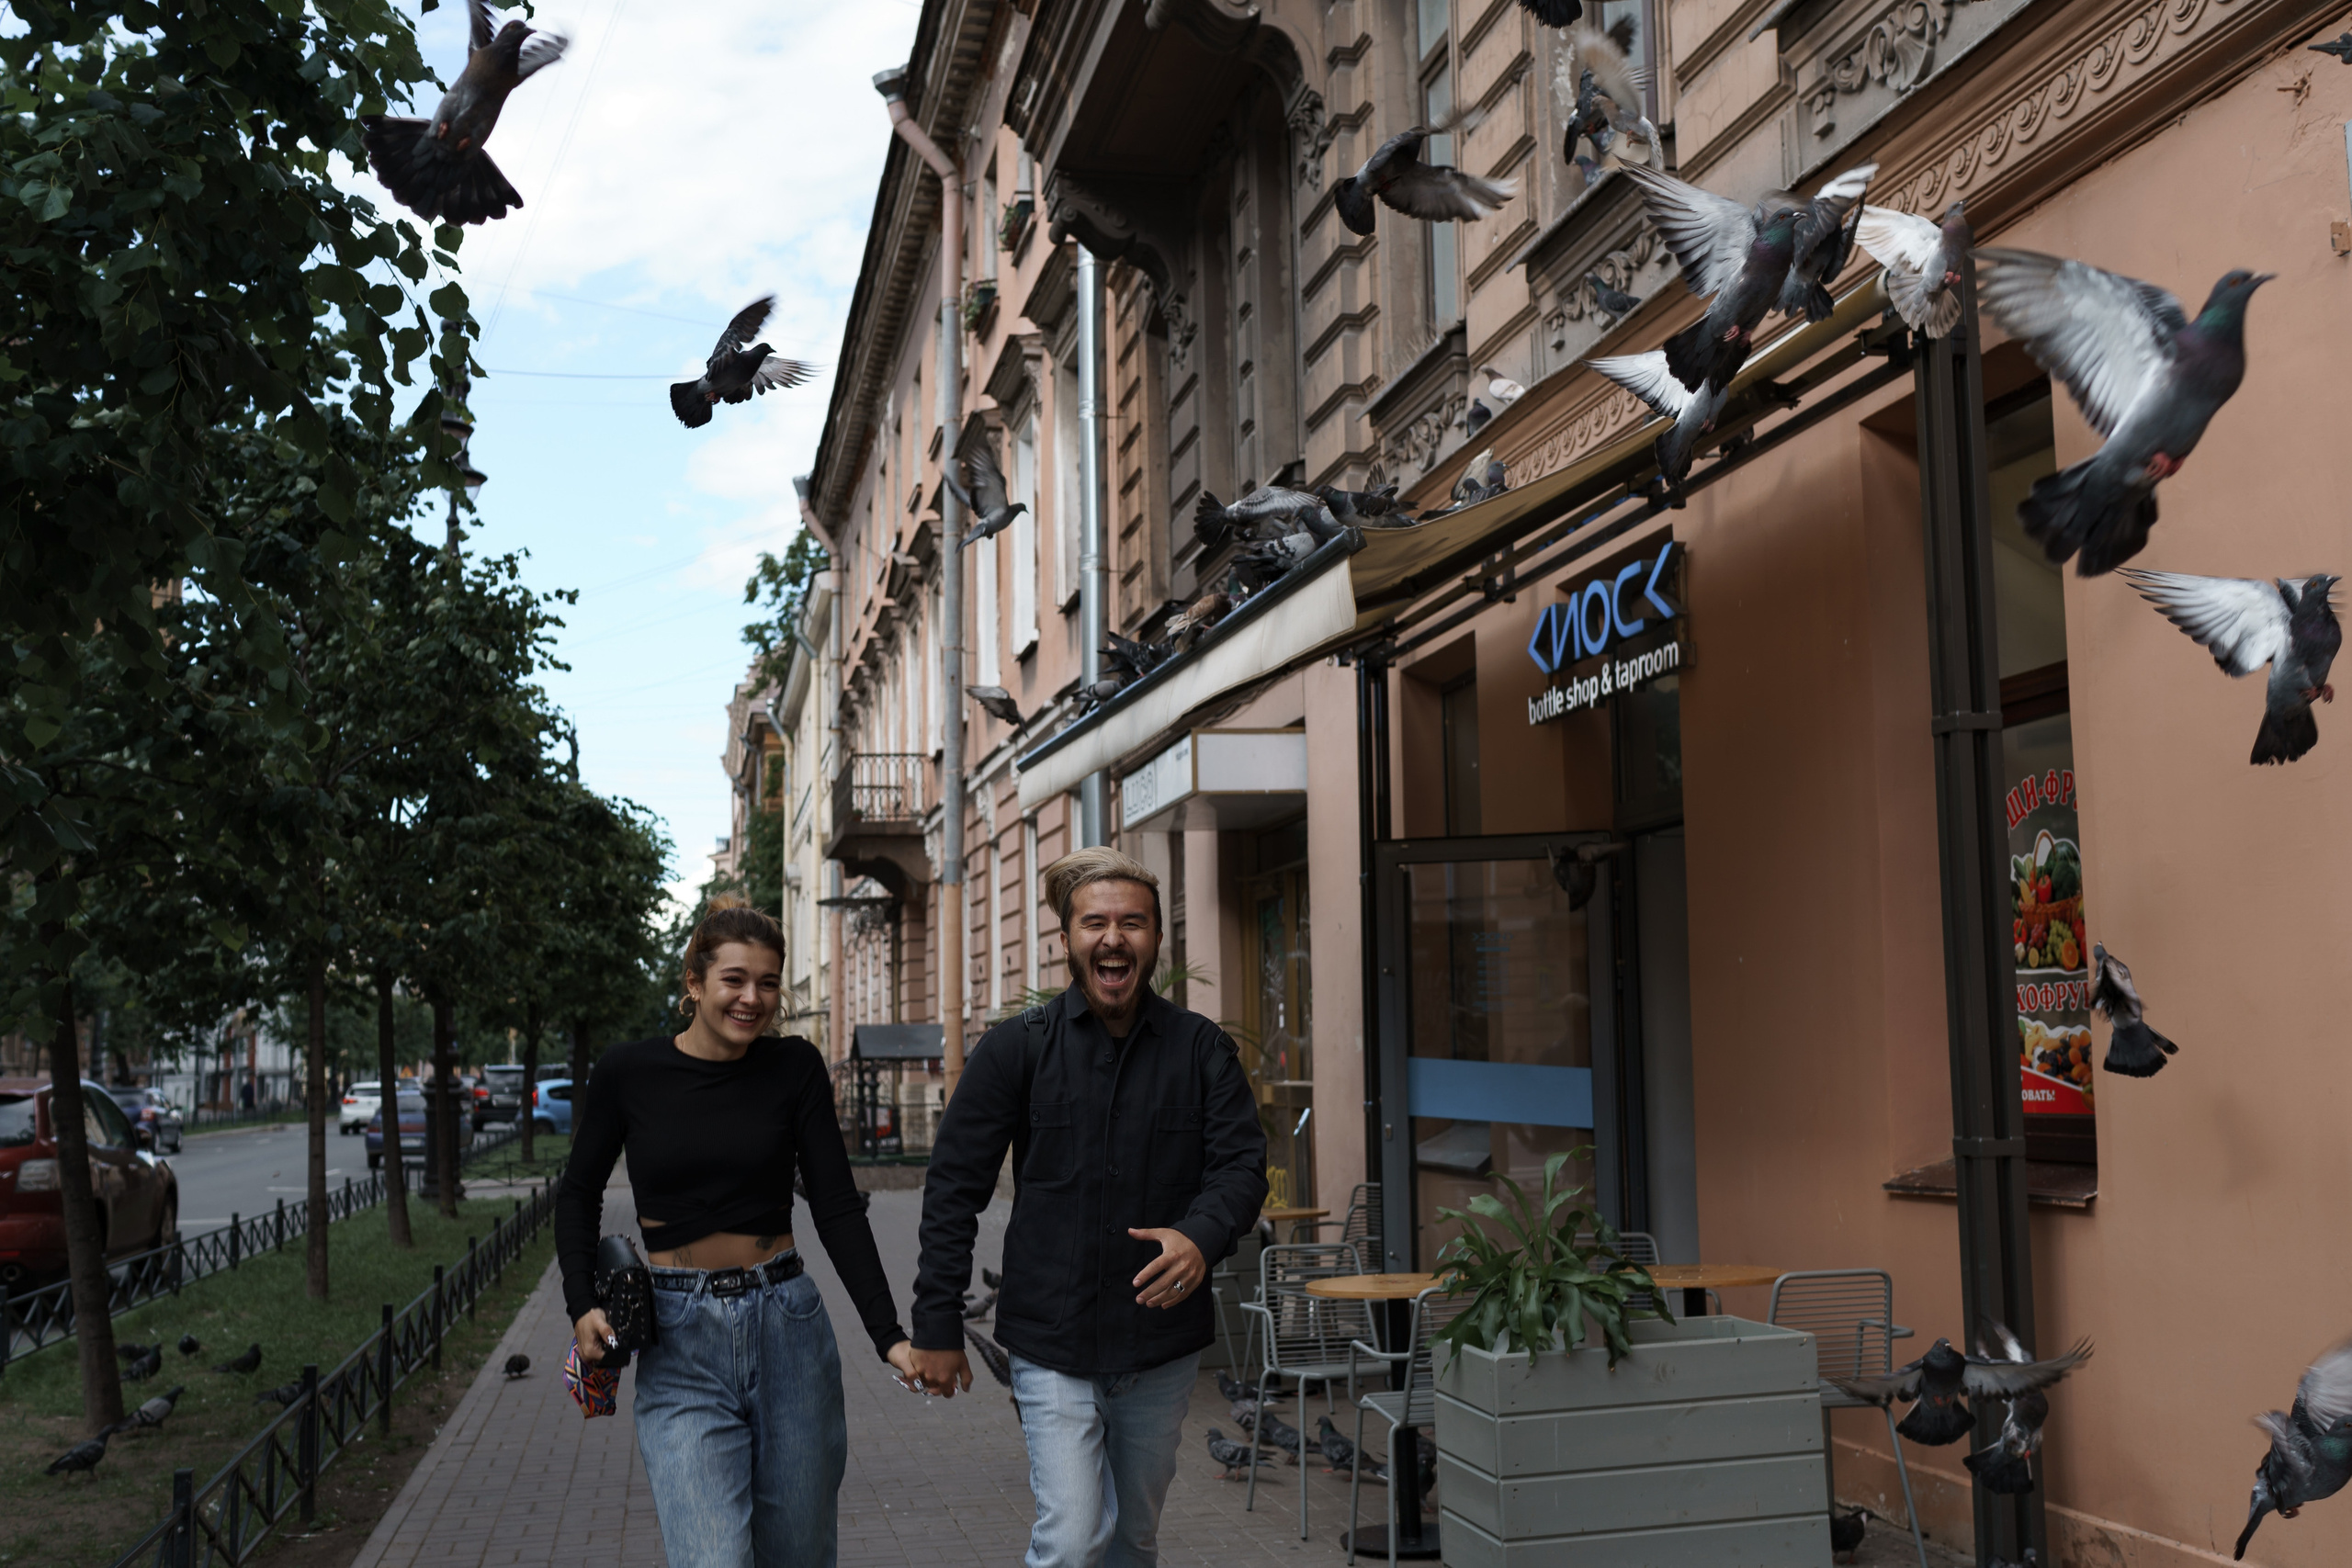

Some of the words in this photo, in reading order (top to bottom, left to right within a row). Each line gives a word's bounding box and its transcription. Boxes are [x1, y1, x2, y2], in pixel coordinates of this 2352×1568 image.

[1528, 685, 1565, 726] bottle
[1566, 676, 1600, 709] shop
[1600, 662, 1613, 695] &
[1614, 641, 1679, 693] taproom
